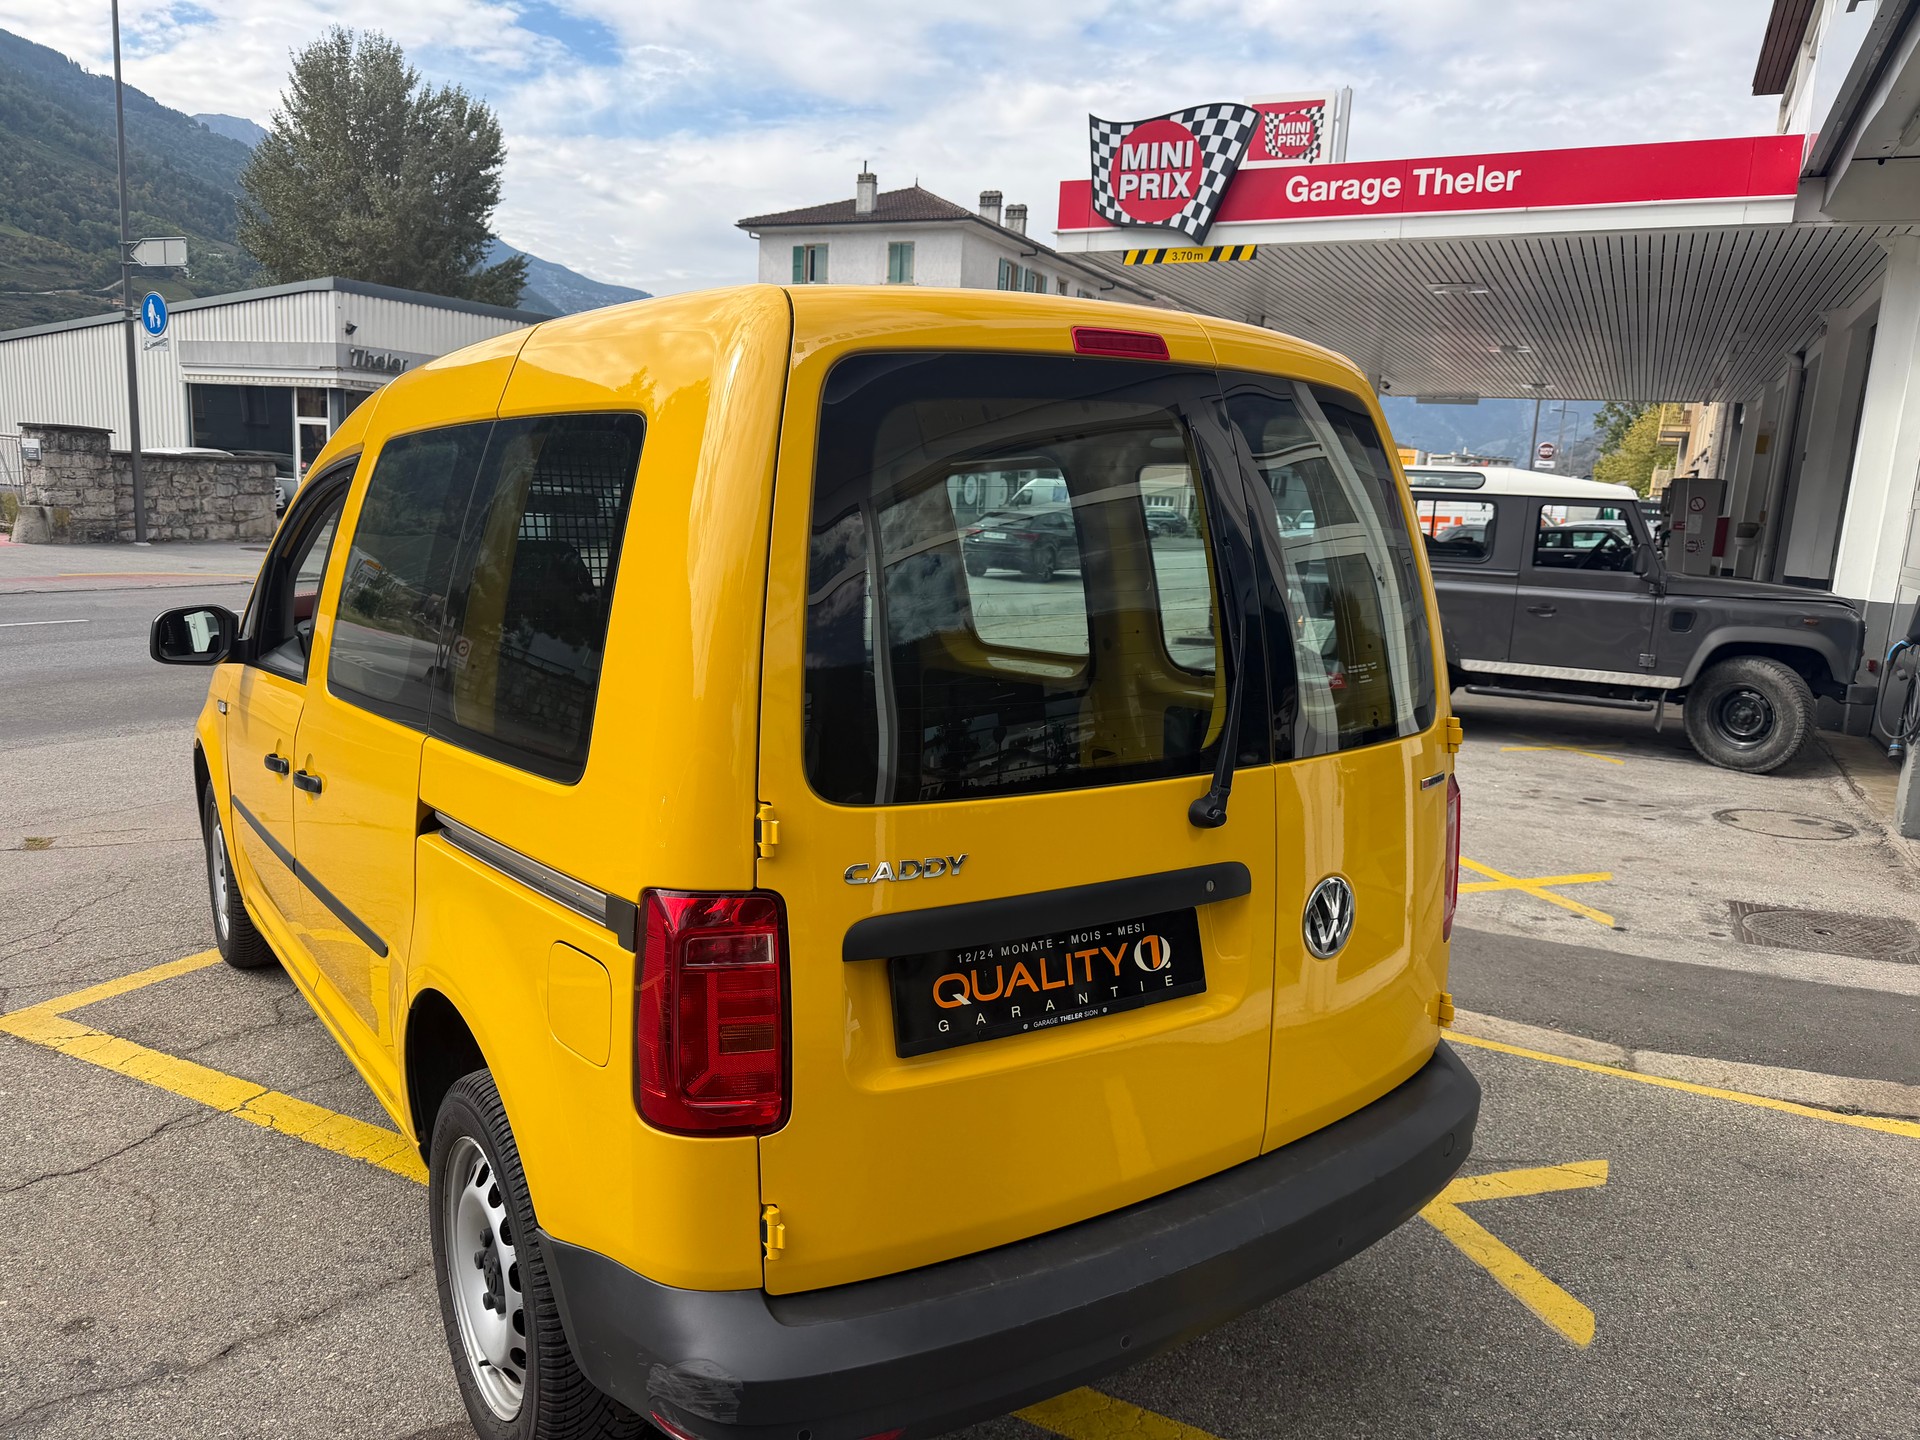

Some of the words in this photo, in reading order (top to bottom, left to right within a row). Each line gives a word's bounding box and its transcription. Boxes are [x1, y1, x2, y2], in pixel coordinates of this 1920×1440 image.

[1277, 134, 1310, 148] PRIX
[1278, 121, 1310, 135] MINI
[1121, 140, 1194, 172] MINI
[1118, 171, 1192, 201] PRIX
[1285, 175, 1402, 206] Garage
[1412, 165, 1522, 196] Theler
[350, 348, 409, 372] Theler
[843, 853, 968, 886] CADDY
[957, 948, 994, 964] 12/24
[1000, 938, 1053, 957] MONATE
[1070, 930, 1101, 945] MOIS
[1117, 922, 1145, 936] MESI
[932, 942, 1129, 1009] QUALITY
[938, 974, 1173, 1032] GARANTIE
[1033, 1016, 1058, 1028] GARAGE
[1059, 1012, 1083, 1022] THELER
[1083, 1009, 1099, 1017] SION
